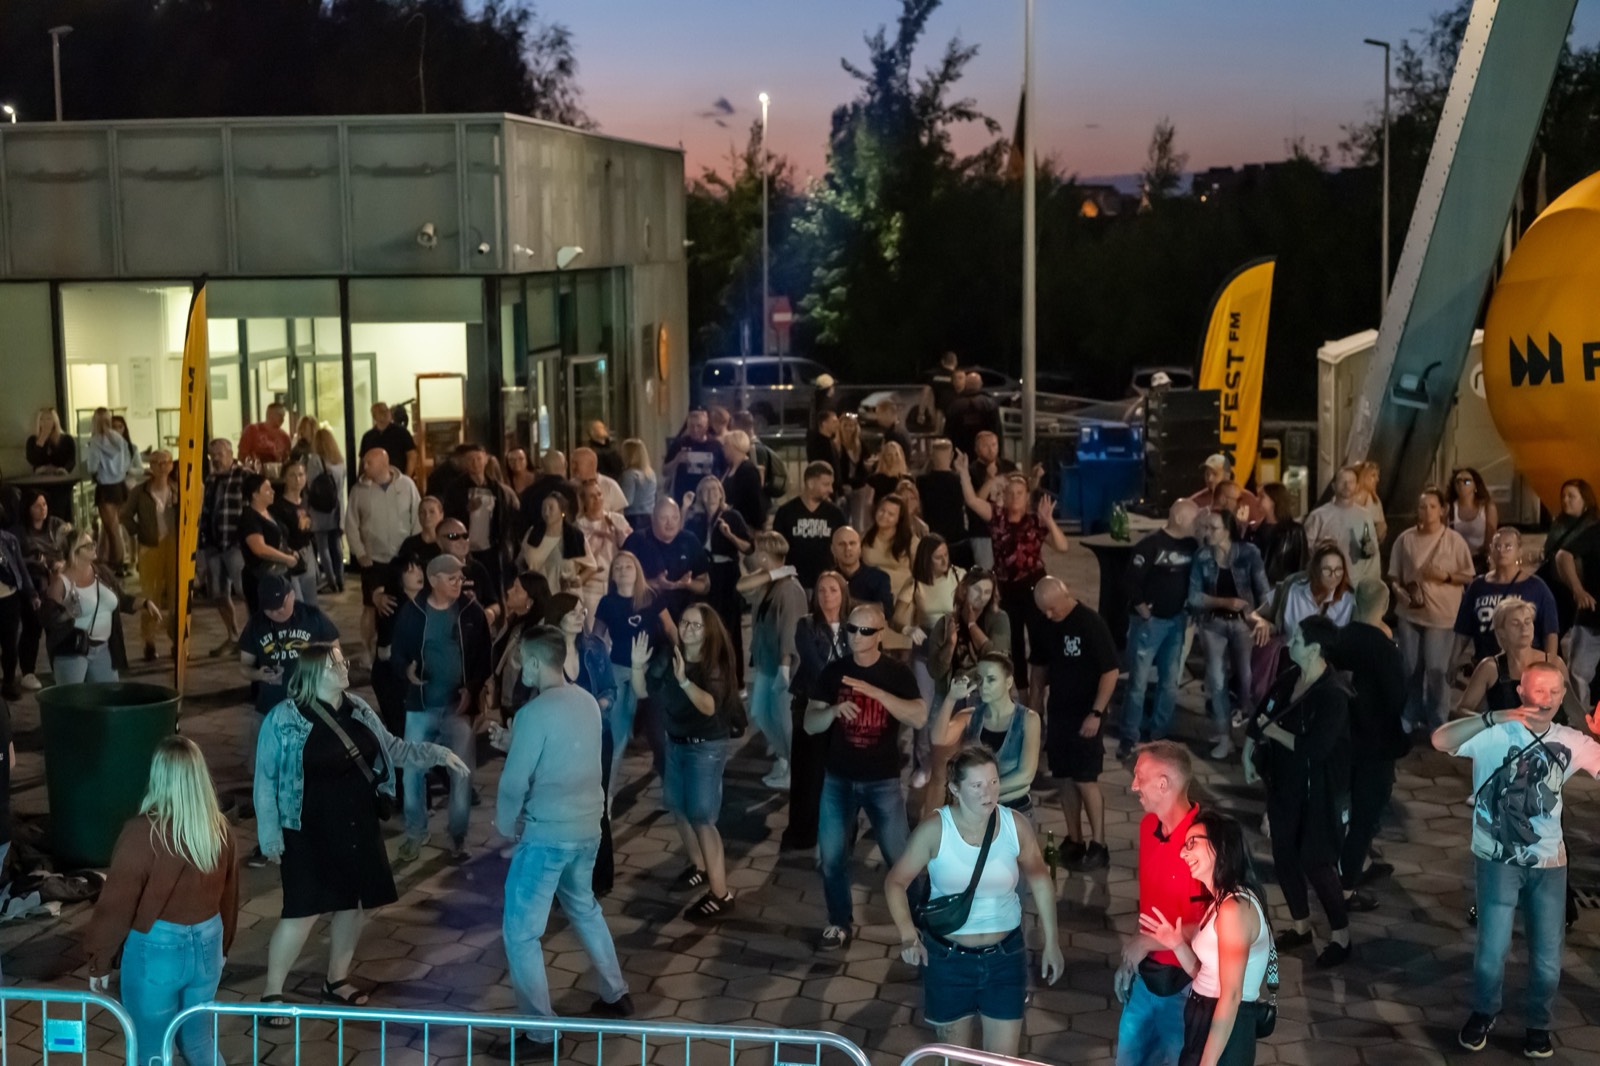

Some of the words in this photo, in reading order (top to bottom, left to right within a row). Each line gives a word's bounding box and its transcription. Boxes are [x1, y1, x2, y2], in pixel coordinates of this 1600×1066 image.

[1229, 312, 1241, 342] FM
[1223, 349, 1244, 432] FEST
[260, 632, 273, 647] LEV
